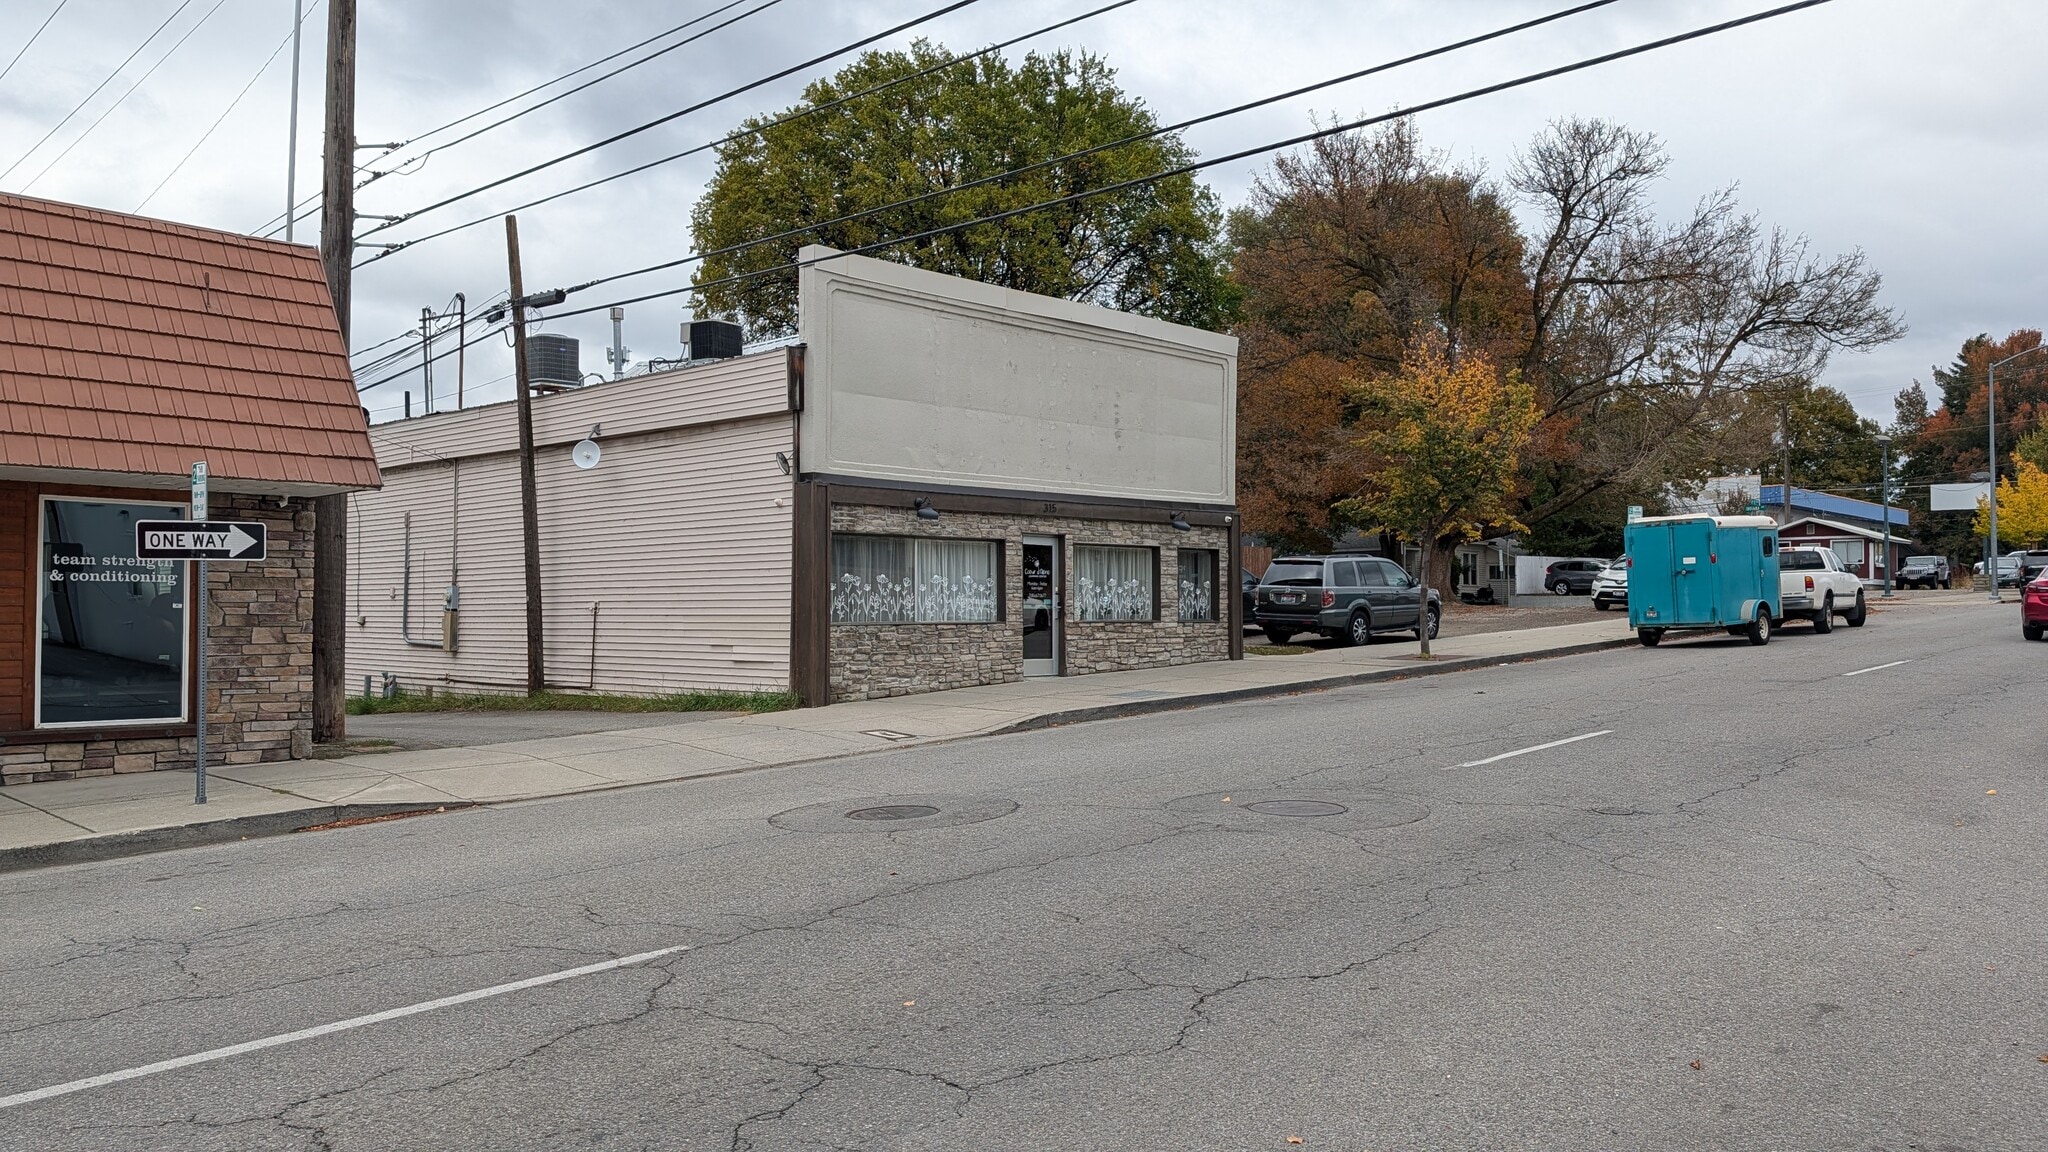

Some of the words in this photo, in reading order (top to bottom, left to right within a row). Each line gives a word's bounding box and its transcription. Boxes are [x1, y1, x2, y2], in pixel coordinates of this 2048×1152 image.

[1043, 503, 1057, 513] 315
[150, 533, 185, 548] ONE
[192, 533, 228, 548] WAY
[52, 553, 97, 565] team
[102, 554, 175, 570] strength
[49, 569, 65, 581] &
[69, 570, 178, 586] conditioning
